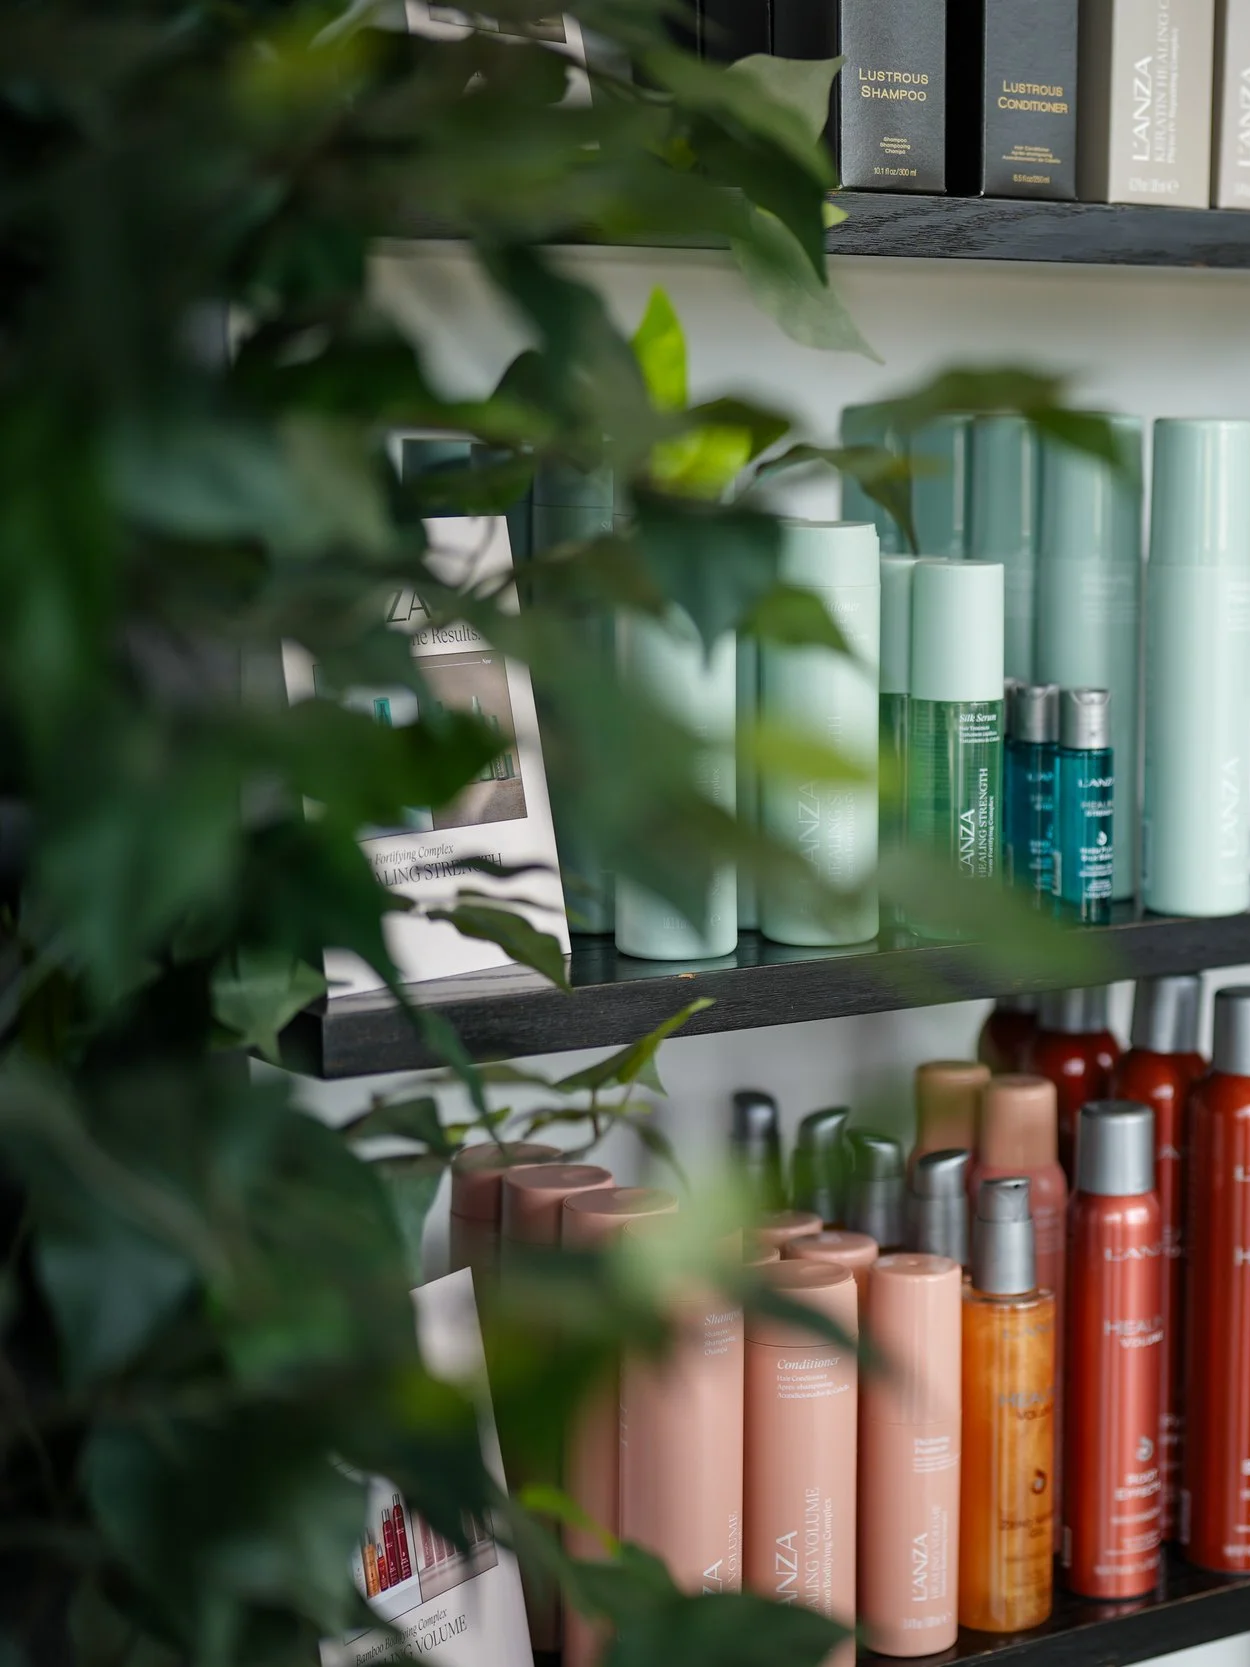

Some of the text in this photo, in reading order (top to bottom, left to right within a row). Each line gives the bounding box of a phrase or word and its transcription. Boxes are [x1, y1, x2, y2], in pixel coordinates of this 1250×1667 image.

[859, 67, 929, 85] LUSTROUS
[1003, 79, 1064, 97] LUSTROUS
[861, 85, 927, 102] SHAMPOO
[998, 96, 1068, 114] CONDITIONER
[1132, 56, 1153, 161] L'ANZA
[431, 624, 481, 645] Results.
[960, 713, 975, 722] Silk
[798, 781, 820, 883] LANZA
[978, 767, 989, 878] HEALING STRENGTH
[375, 850, 417, 866] Fortifying
[418, 843, 454, 860] Complex
[376, 864, 421, 887] ALING
[777, 1356, 840, 1370] Conditioner
[823, 1497, 833, 1540] Complex
[805, 1486, 820, 1612] ALING VOLUME
[775, 1530, 798, 1608] ANZA
[912, 1532, 928, 1602] L'ANZA
[823, 1588, 833, 1617] mboo
[356, 1644, 384, 1667] Bamboo
[417, 1608, 447, 1631] Complex
[415, 1614, 468, 1654] VOLUME
